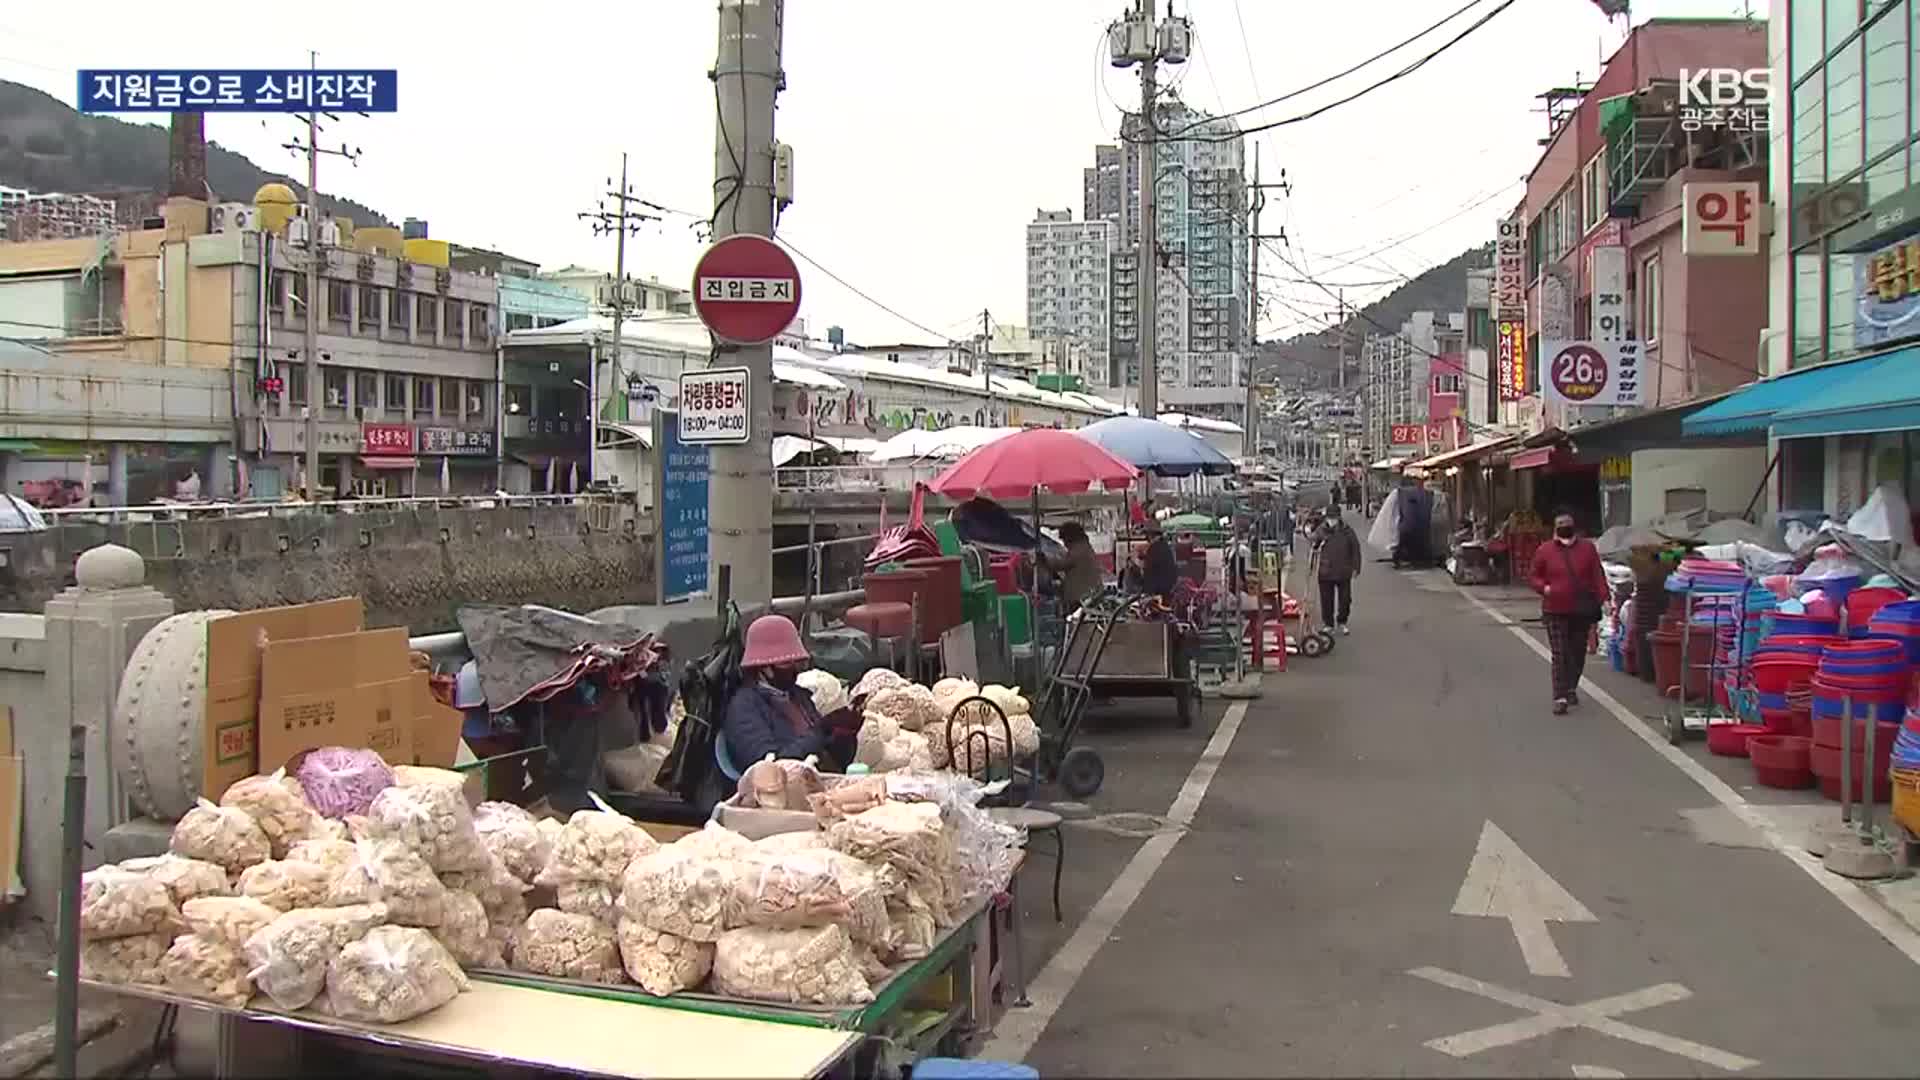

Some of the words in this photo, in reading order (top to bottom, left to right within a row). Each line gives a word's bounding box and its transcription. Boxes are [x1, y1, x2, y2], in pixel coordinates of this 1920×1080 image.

[1696, 190, 1751, 247] 약
[706, 280, 789, 299] 진입금지
[683, 379, 745, 412] 차량통행금지
